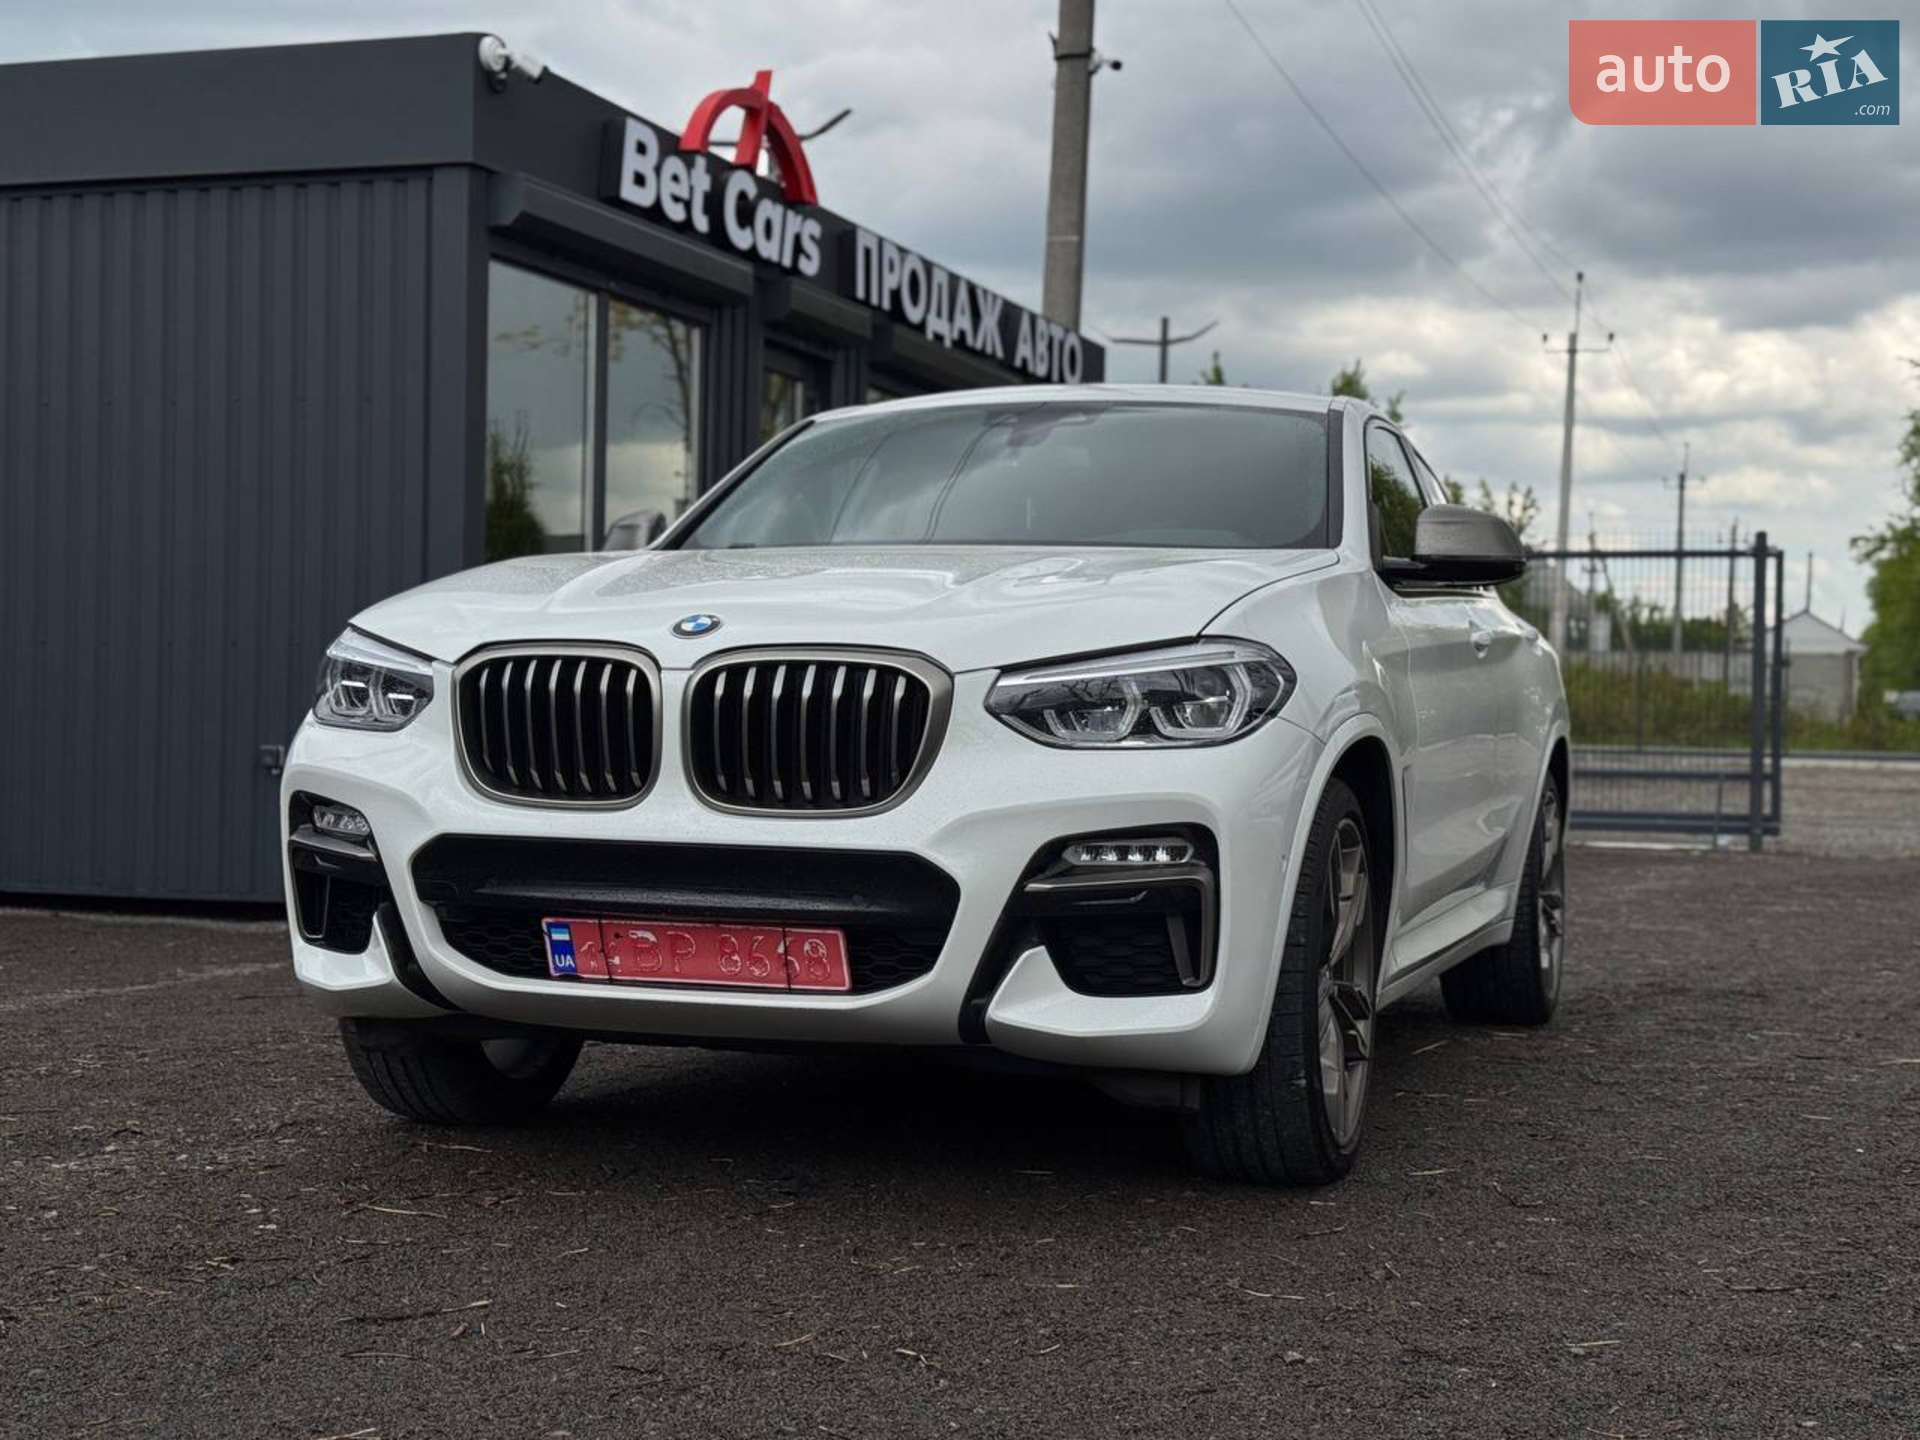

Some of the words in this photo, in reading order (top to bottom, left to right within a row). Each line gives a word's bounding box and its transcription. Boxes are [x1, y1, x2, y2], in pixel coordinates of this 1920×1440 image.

[619, 116, 710, 235] Bet
[723, 169, 822, 278] Cars
[854, 226, 1002, 360] ПРОДАЖ
[1013, 308, 1085, 384] АВТО
[553, 952, 577, 969] UA
